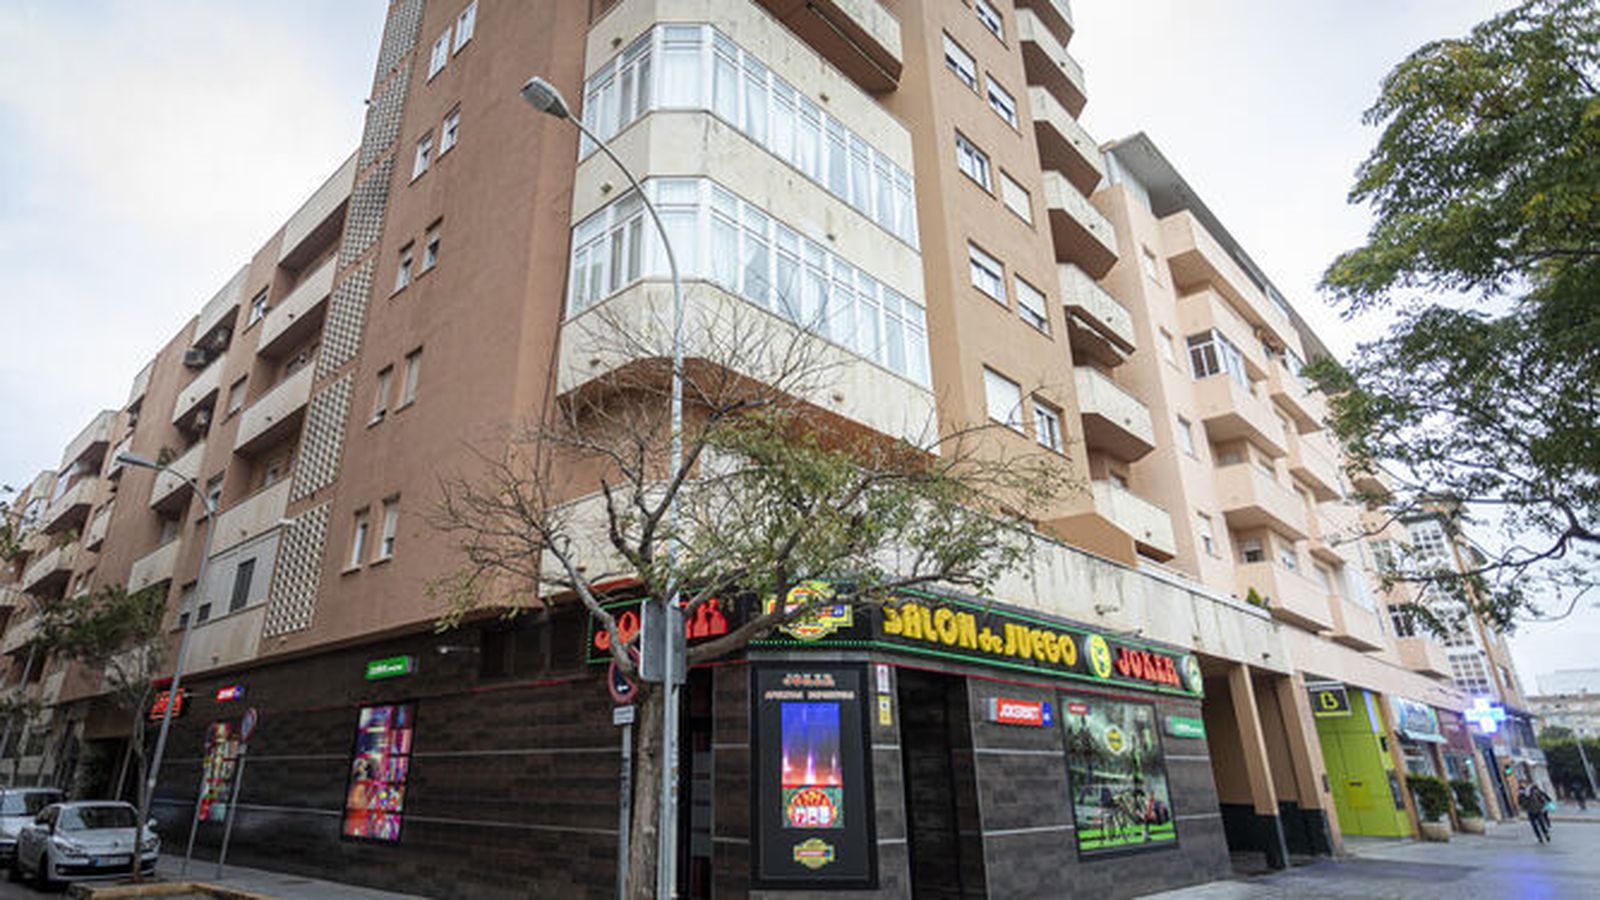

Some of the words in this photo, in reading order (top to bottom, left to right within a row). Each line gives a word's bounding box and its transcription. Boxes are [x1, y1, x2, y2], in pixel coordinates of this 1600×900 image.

[883, 597, 977, 650] SALON
[978, 626, 1003, 654] de
[1004, 623, 1077, 667] JUEGO
[1115, 646, 1181, 688] JOKER
